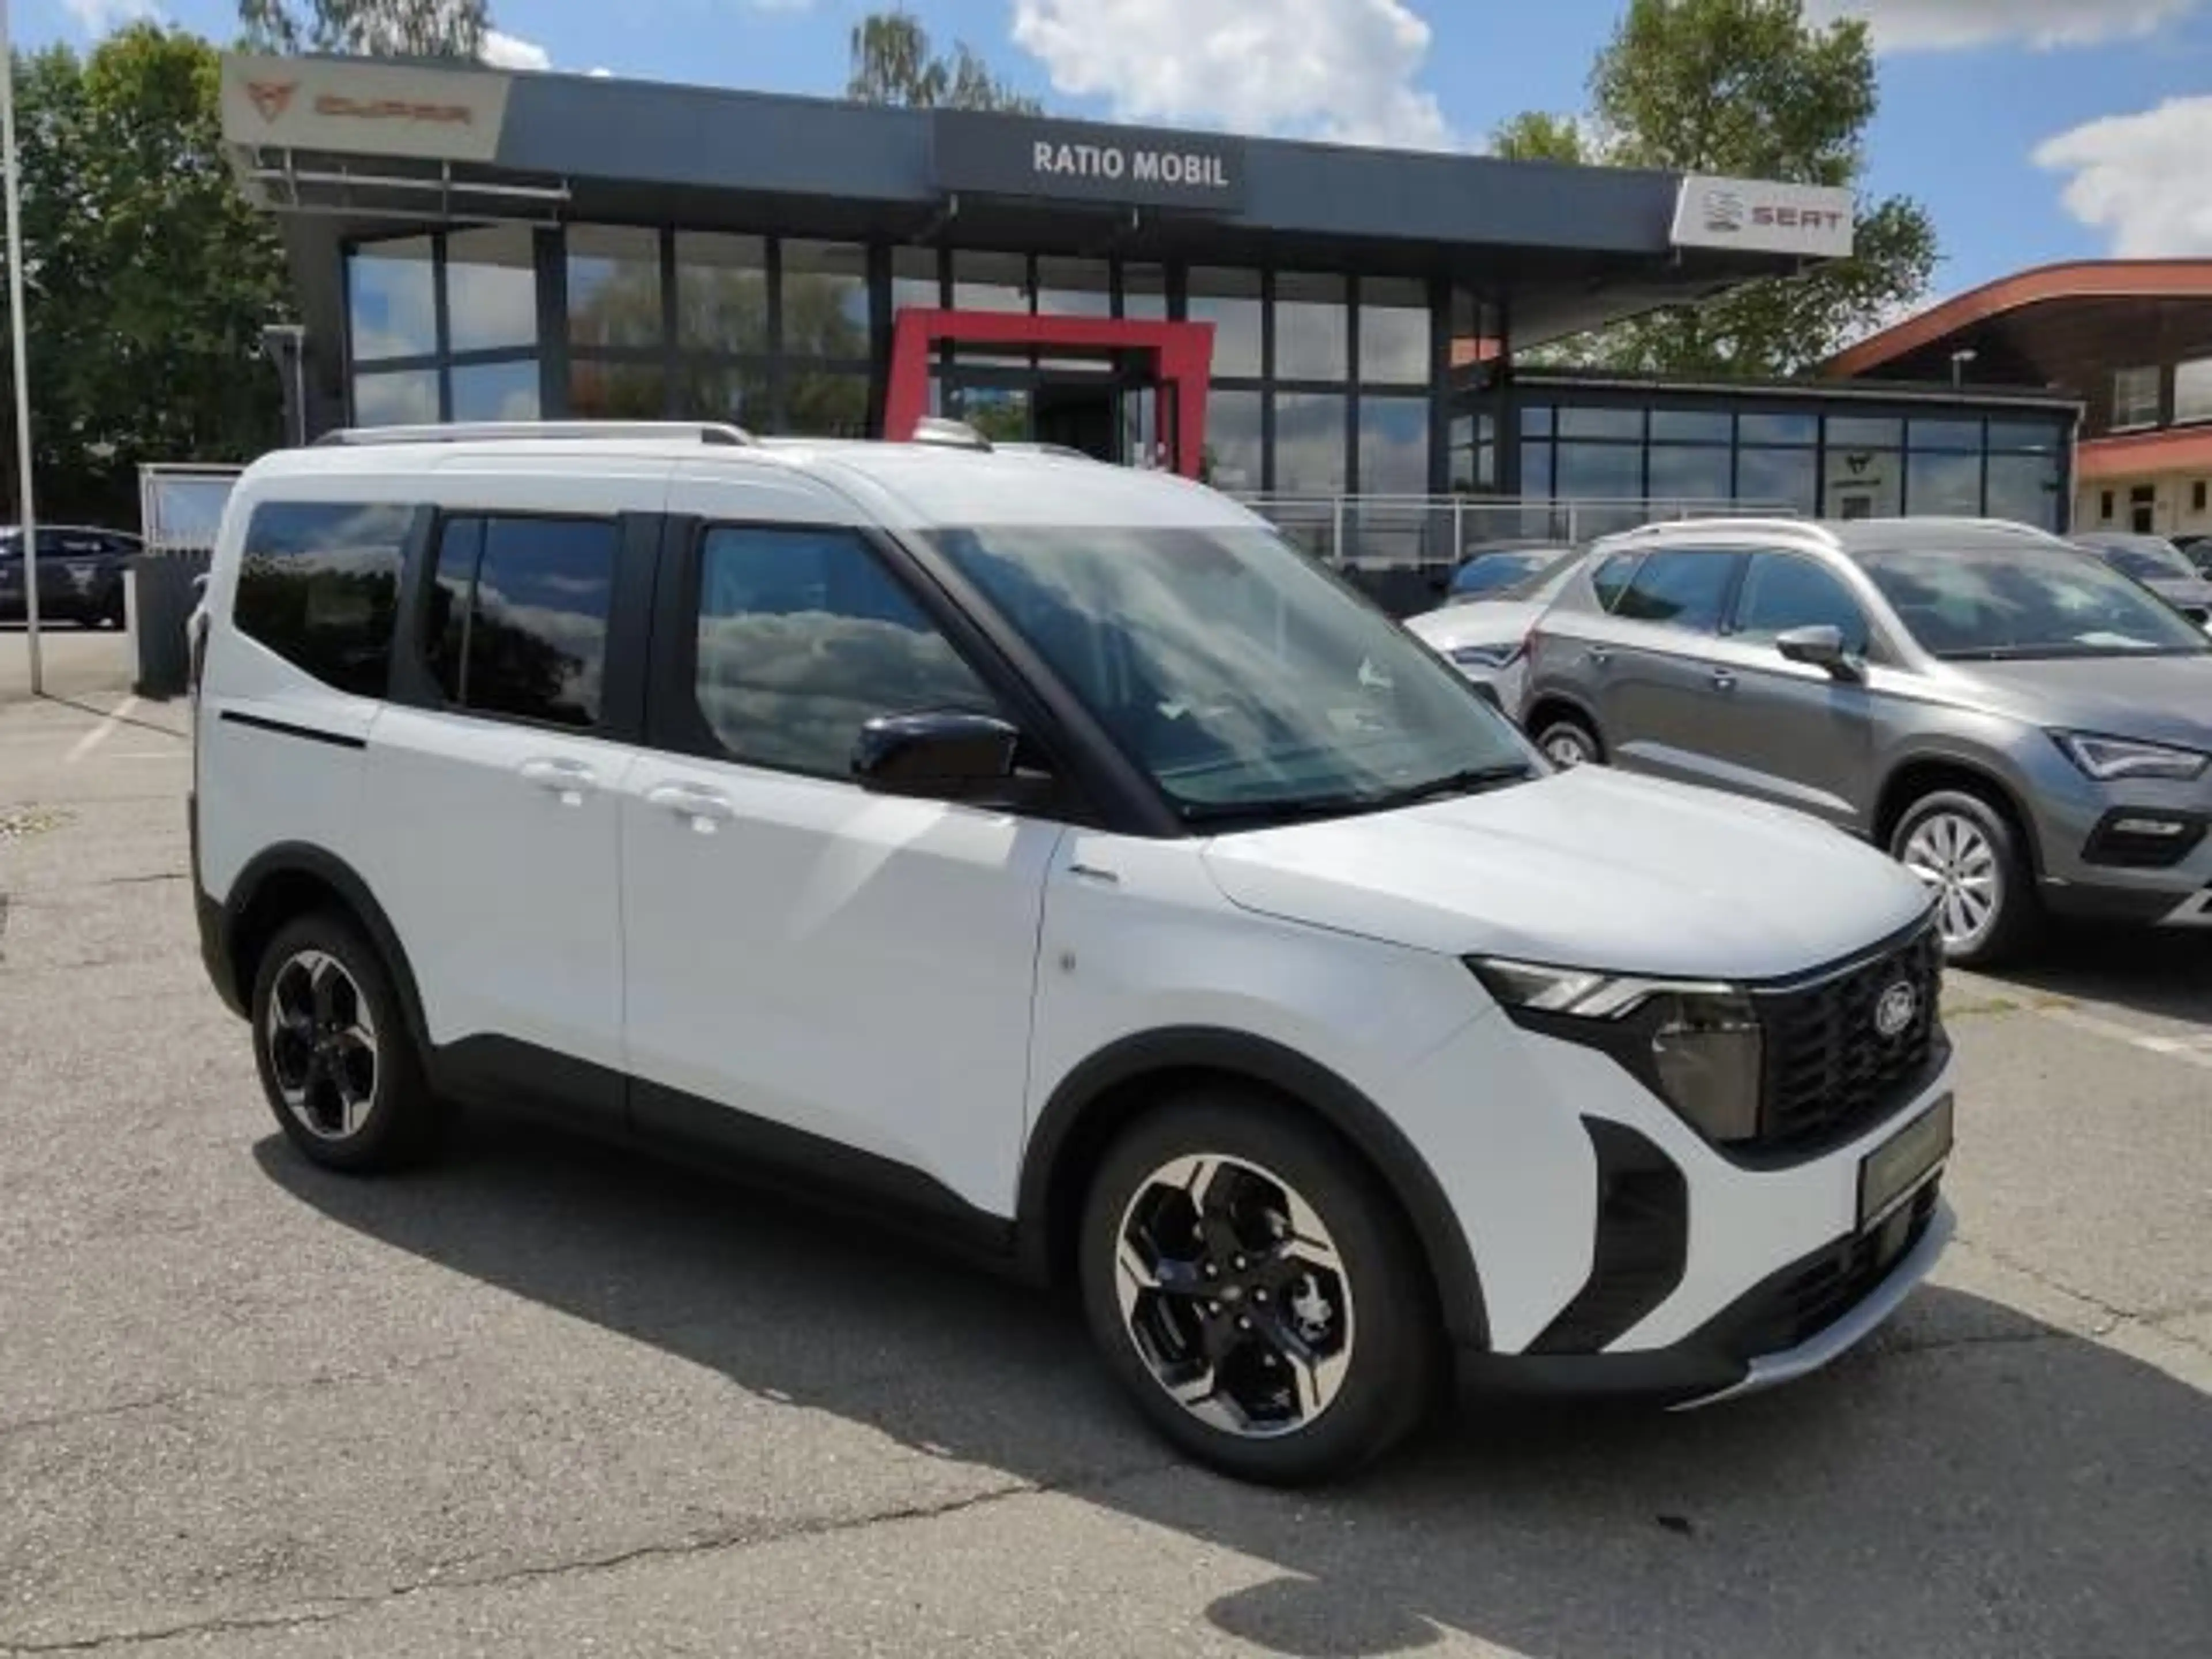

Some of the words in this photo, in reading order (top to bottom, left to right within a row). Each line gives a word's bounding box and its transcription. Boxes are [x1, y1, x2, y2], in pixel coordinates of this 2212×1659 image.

[1033, 141, 1124, 180] RATIO
[1133, 150, 1230, 188] MOBIL
[1752, 206, 1843, 232] SEAT
